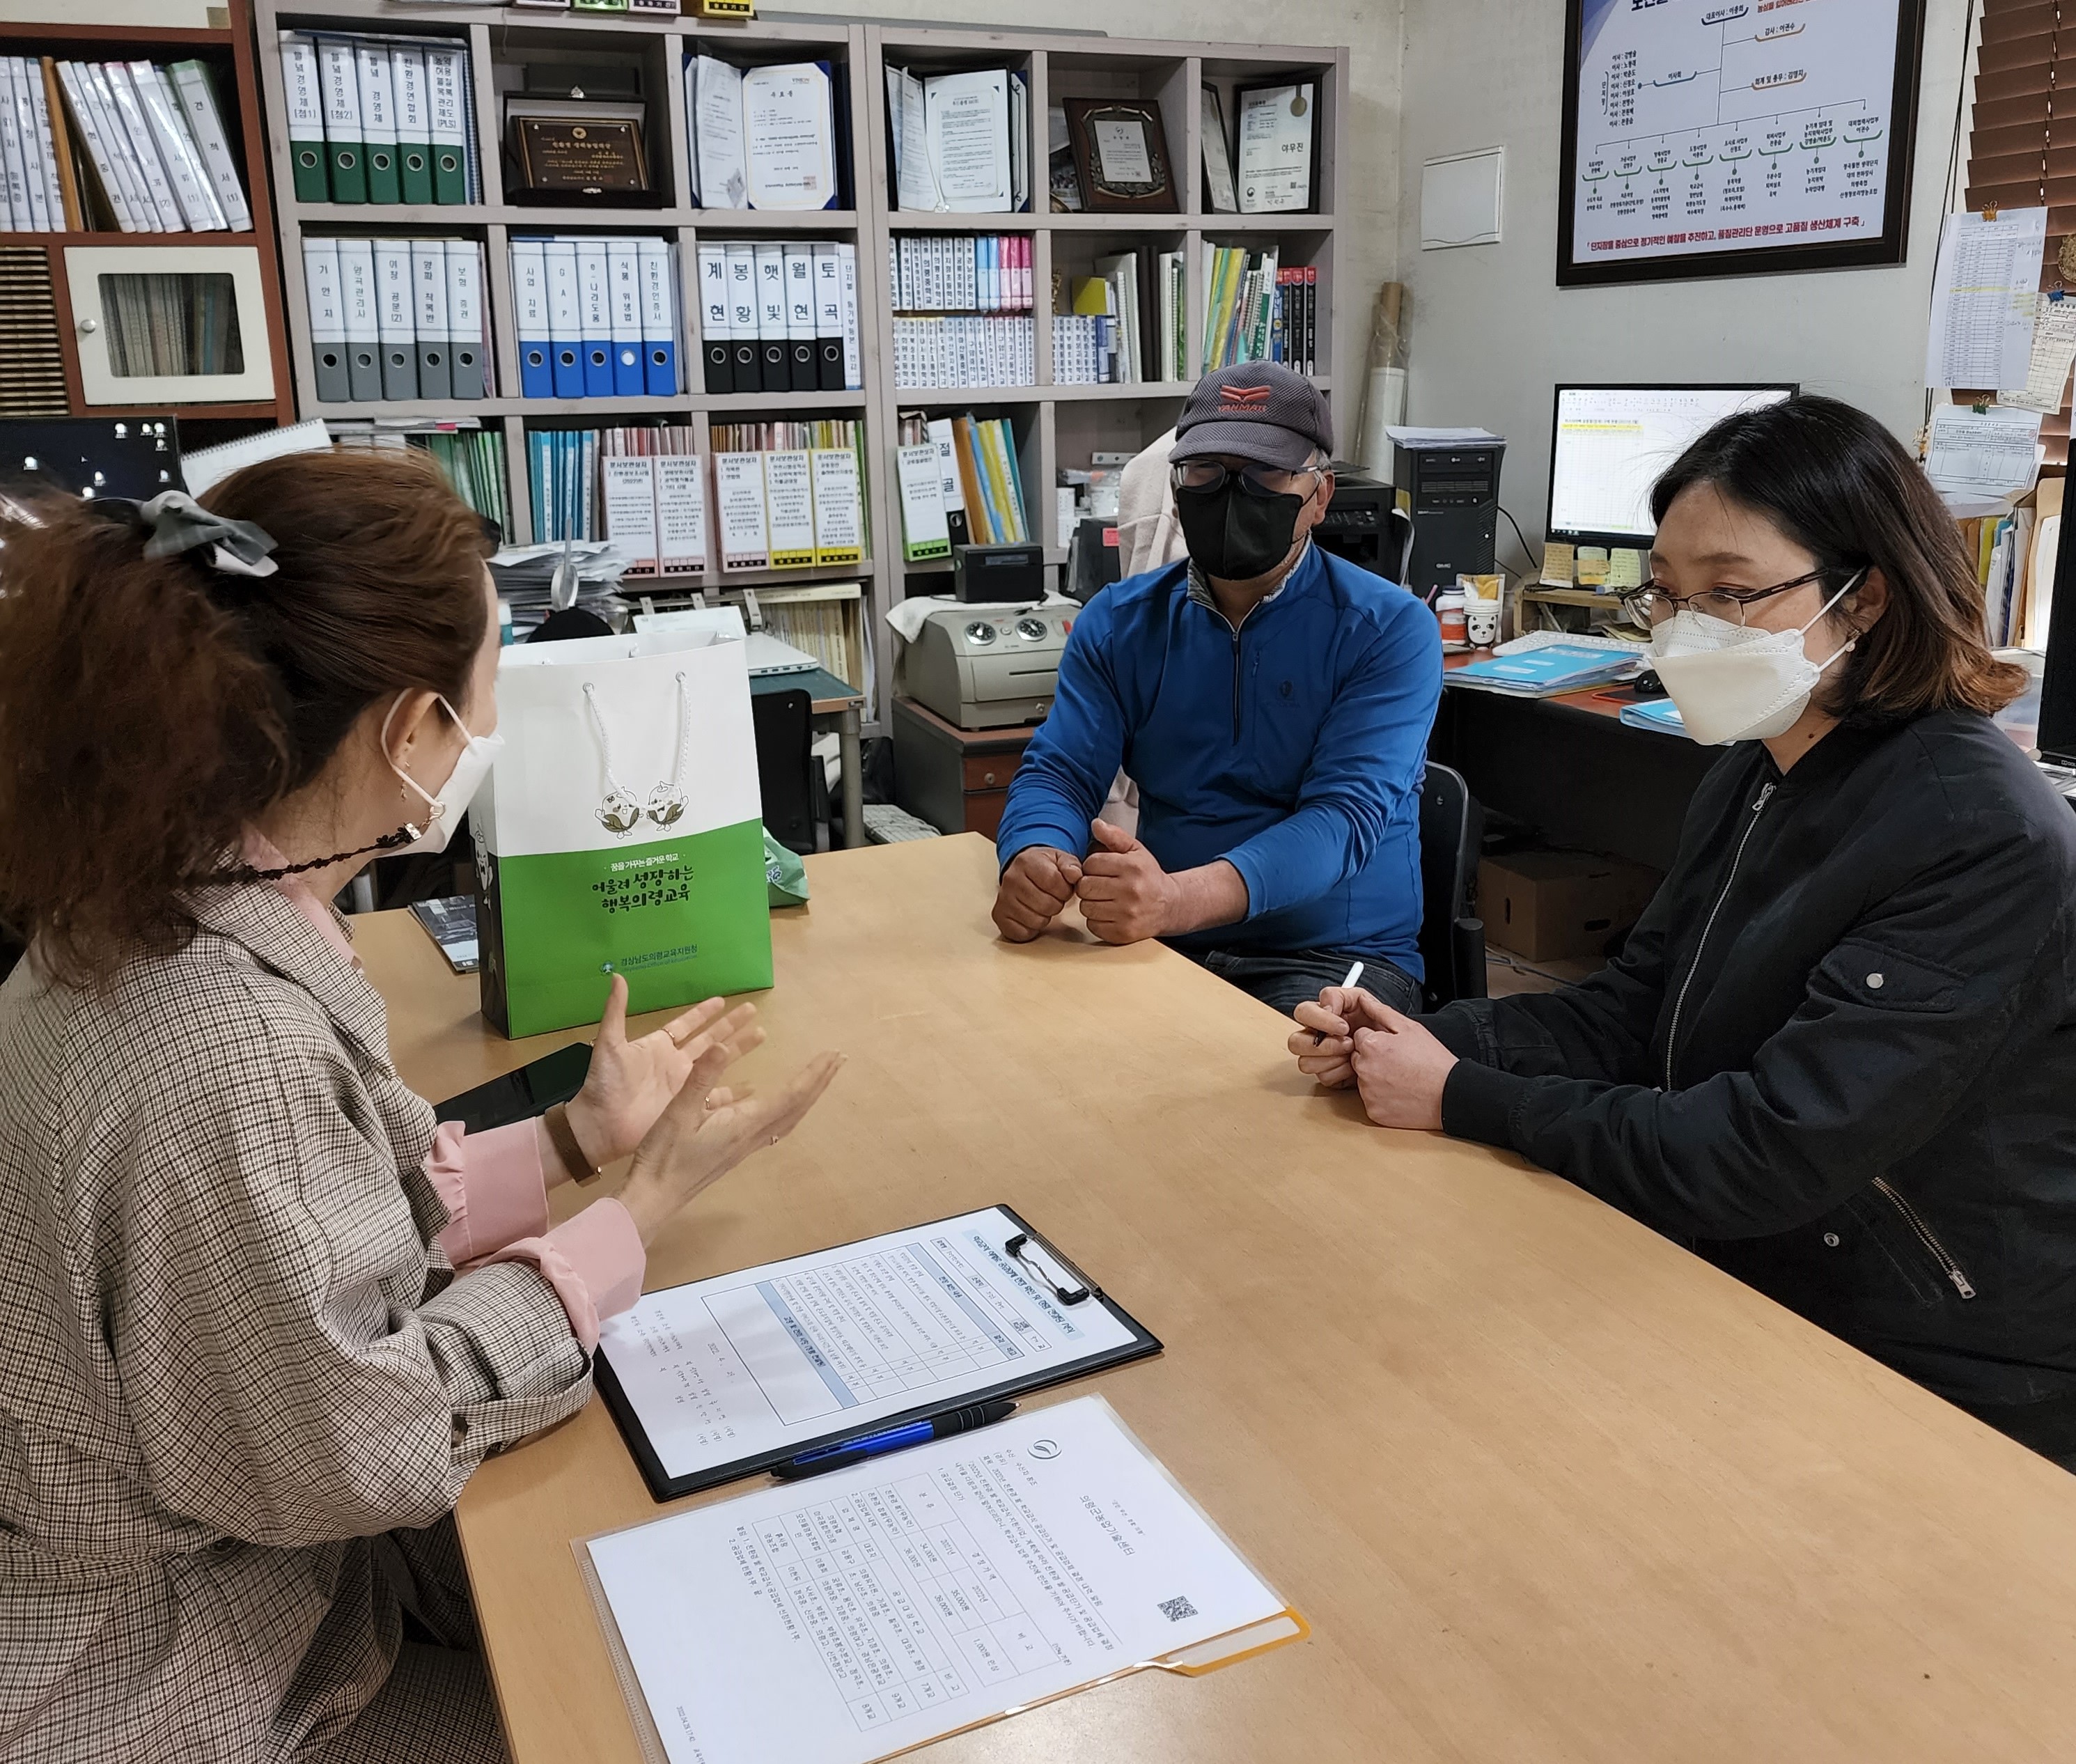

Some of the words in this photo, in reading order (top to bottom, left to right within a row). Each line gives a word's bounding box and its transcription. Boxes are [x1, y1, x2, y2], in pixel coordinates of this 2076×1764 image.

[1281, 142, 1304, 154] 야무진
[1614, 237, 1639, 249] 중심으로
[1640, 234, 1666, 247] 정기적인
[1687, 230, 1717, 243] 추진하고,
[1717, 226, 1753, 240] 품질관리단
[1754, 223, 1784, 237] 운영으로
[1785, 221, 1808, 234] 고품질
[1809, 217, 1841, 232] 생산체계
[1842, 215, 1859, 229] 구축
[526, 267, 536, 287] 사업
[621, 261, 630, 281] 식품
[650, 260, 662, 321] 친환경인증서
[622, 292, 632, 322] 위생법
[610, 860, 625, 872] 꿈을
[625, 859, 646, 870] 가꾸는
[646, 855, 665, 867] 즐거운
[665, 852, 679, 862] 학교
[592, 879, 630, 895] 어울려
[633, 864, 694, 889] 성장하는
[621, 944, 698, 967] 경상남도의령교육지원청
[1003, 1448, 1016, 1458] 수신
[1013, 1461, 1031, 1476] 수신자
[1018, 1504, 1038, 1523] 학교급식
[1033, 1522, 1054, 1543] 공급단가
[1077, 1494, 1137, 1556] 의령군농업기술센터
[992, 1498, 1013, 1517] 학교급식
[1060, 1586, 1084, 1609] 공급단가
[1047, 1590, 1066, 1607] 기하여
[1060, 1607, 1079, 1625] 주시기
[1072, 1623, 1098, 1649] 바랍니다.
[971, 1637, 991, 1658] 1,000원
